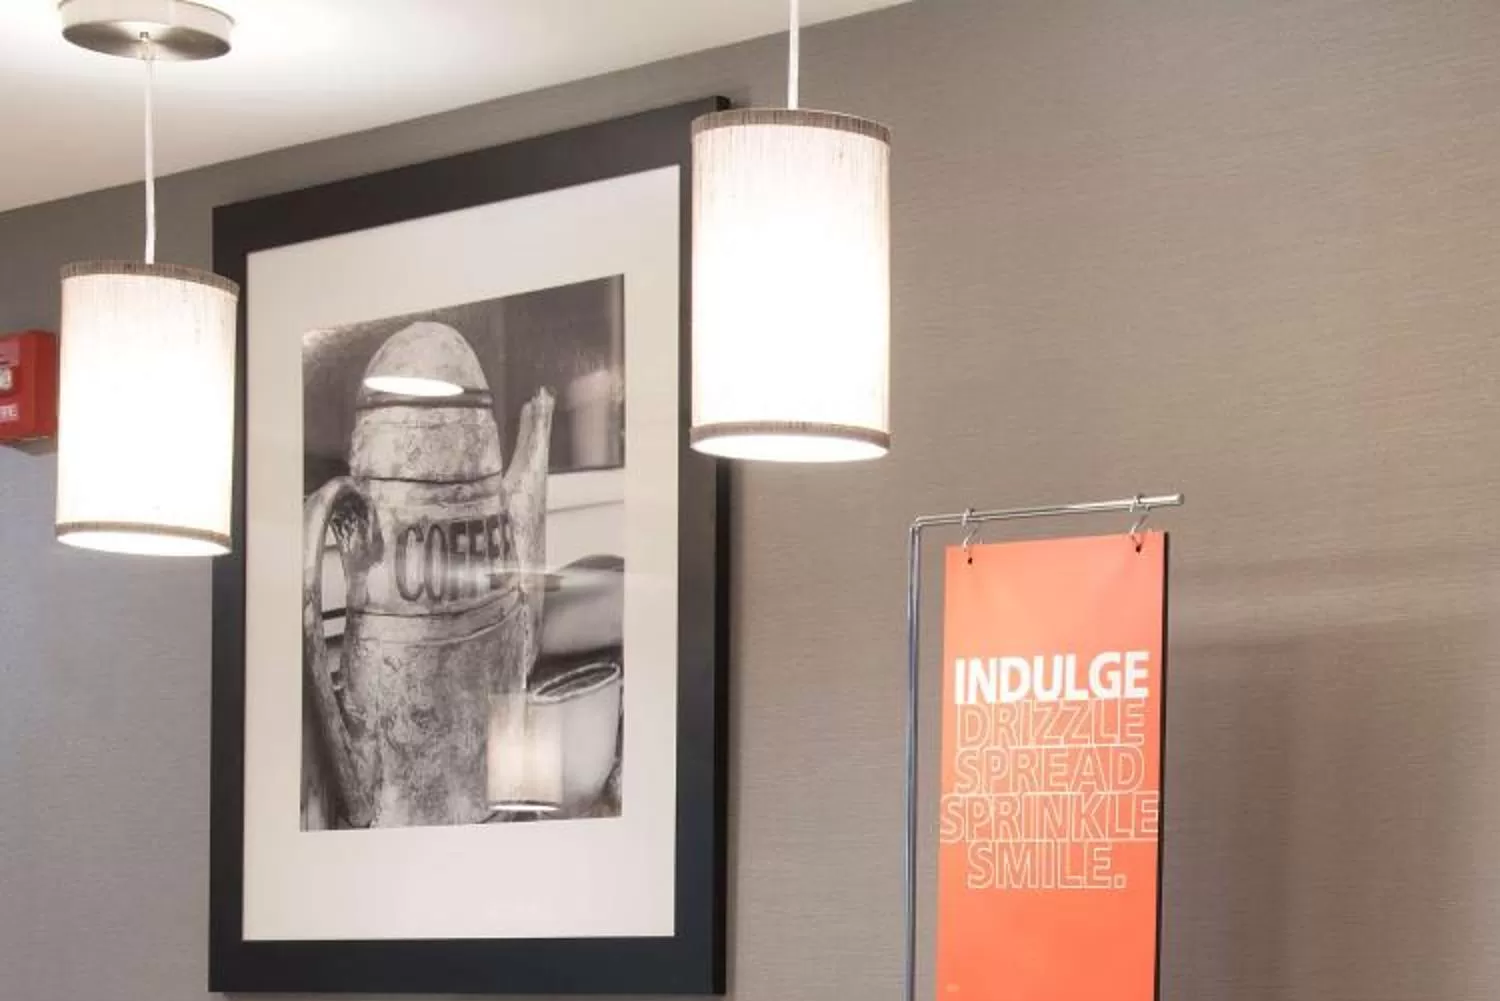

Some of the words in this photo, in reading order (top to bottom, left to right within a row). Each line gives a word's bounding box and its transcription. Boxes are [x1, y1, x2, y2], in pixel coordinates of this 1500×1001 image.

[954, 650, 1150, 704] INDULGE
[956, 699, 1145, 749] DRIZZLE
[954, 744, 1145, 795] SPREAD
[940, 790, 1159, 843] SPRINKLE
[966, 838, 1128, 889] SMILE.
